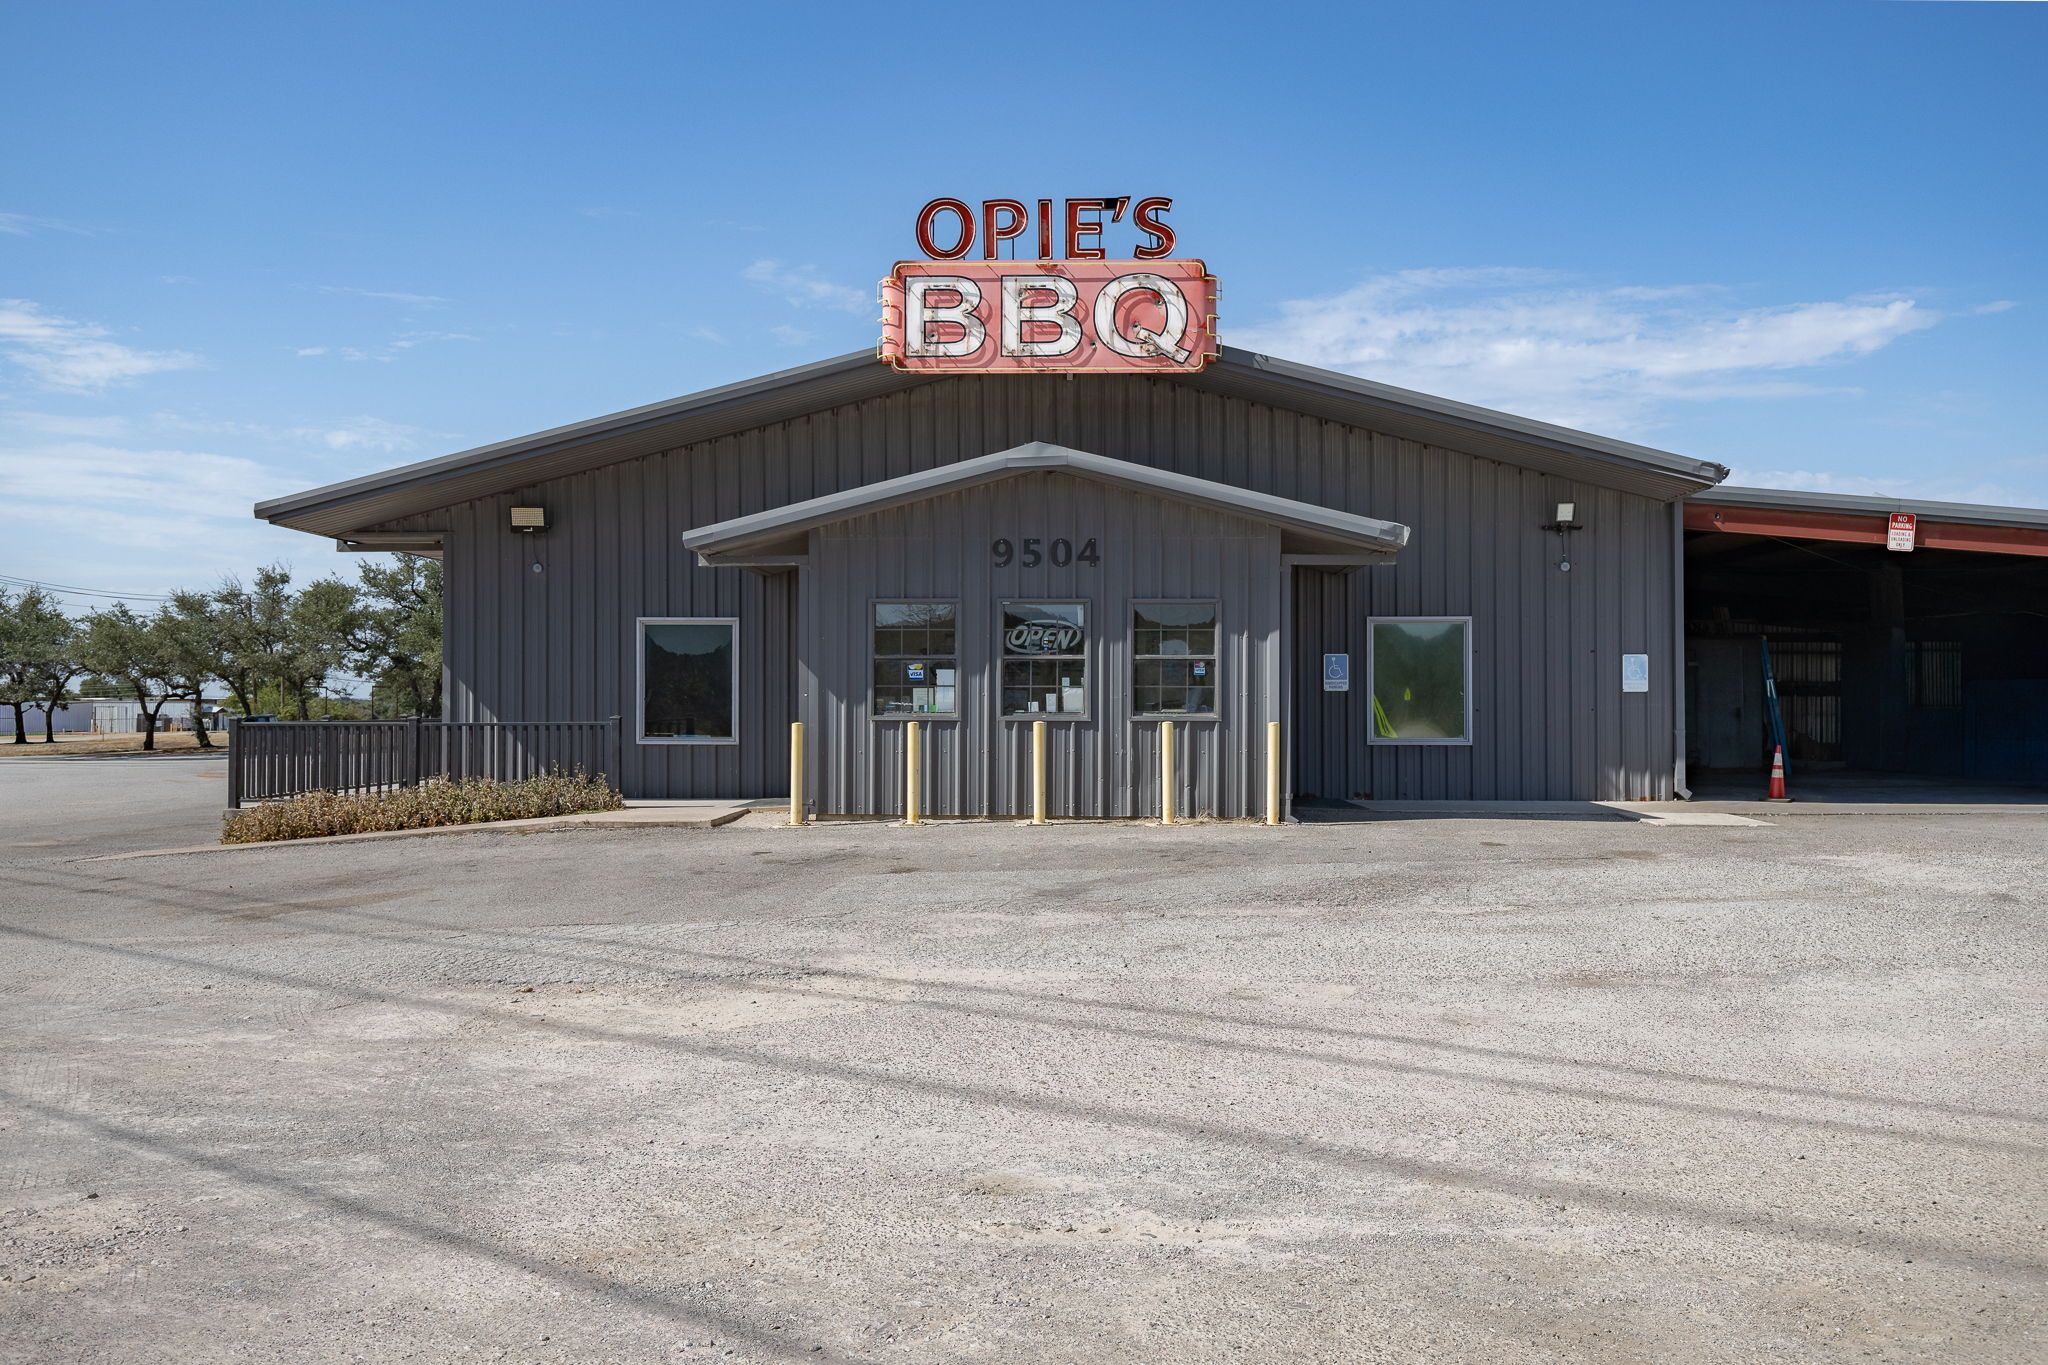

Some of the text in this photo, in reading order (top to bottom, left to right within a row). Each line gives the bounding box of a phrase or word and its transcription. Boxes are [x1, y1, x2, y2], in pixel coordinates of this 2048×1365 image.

[915, 196, 1177, 260] OPIE'S
[904, 272, 1193, 364] BBQ
[992, 538, 1100, 568] 9504
[1010, 625, 1074, 649] OPEN
